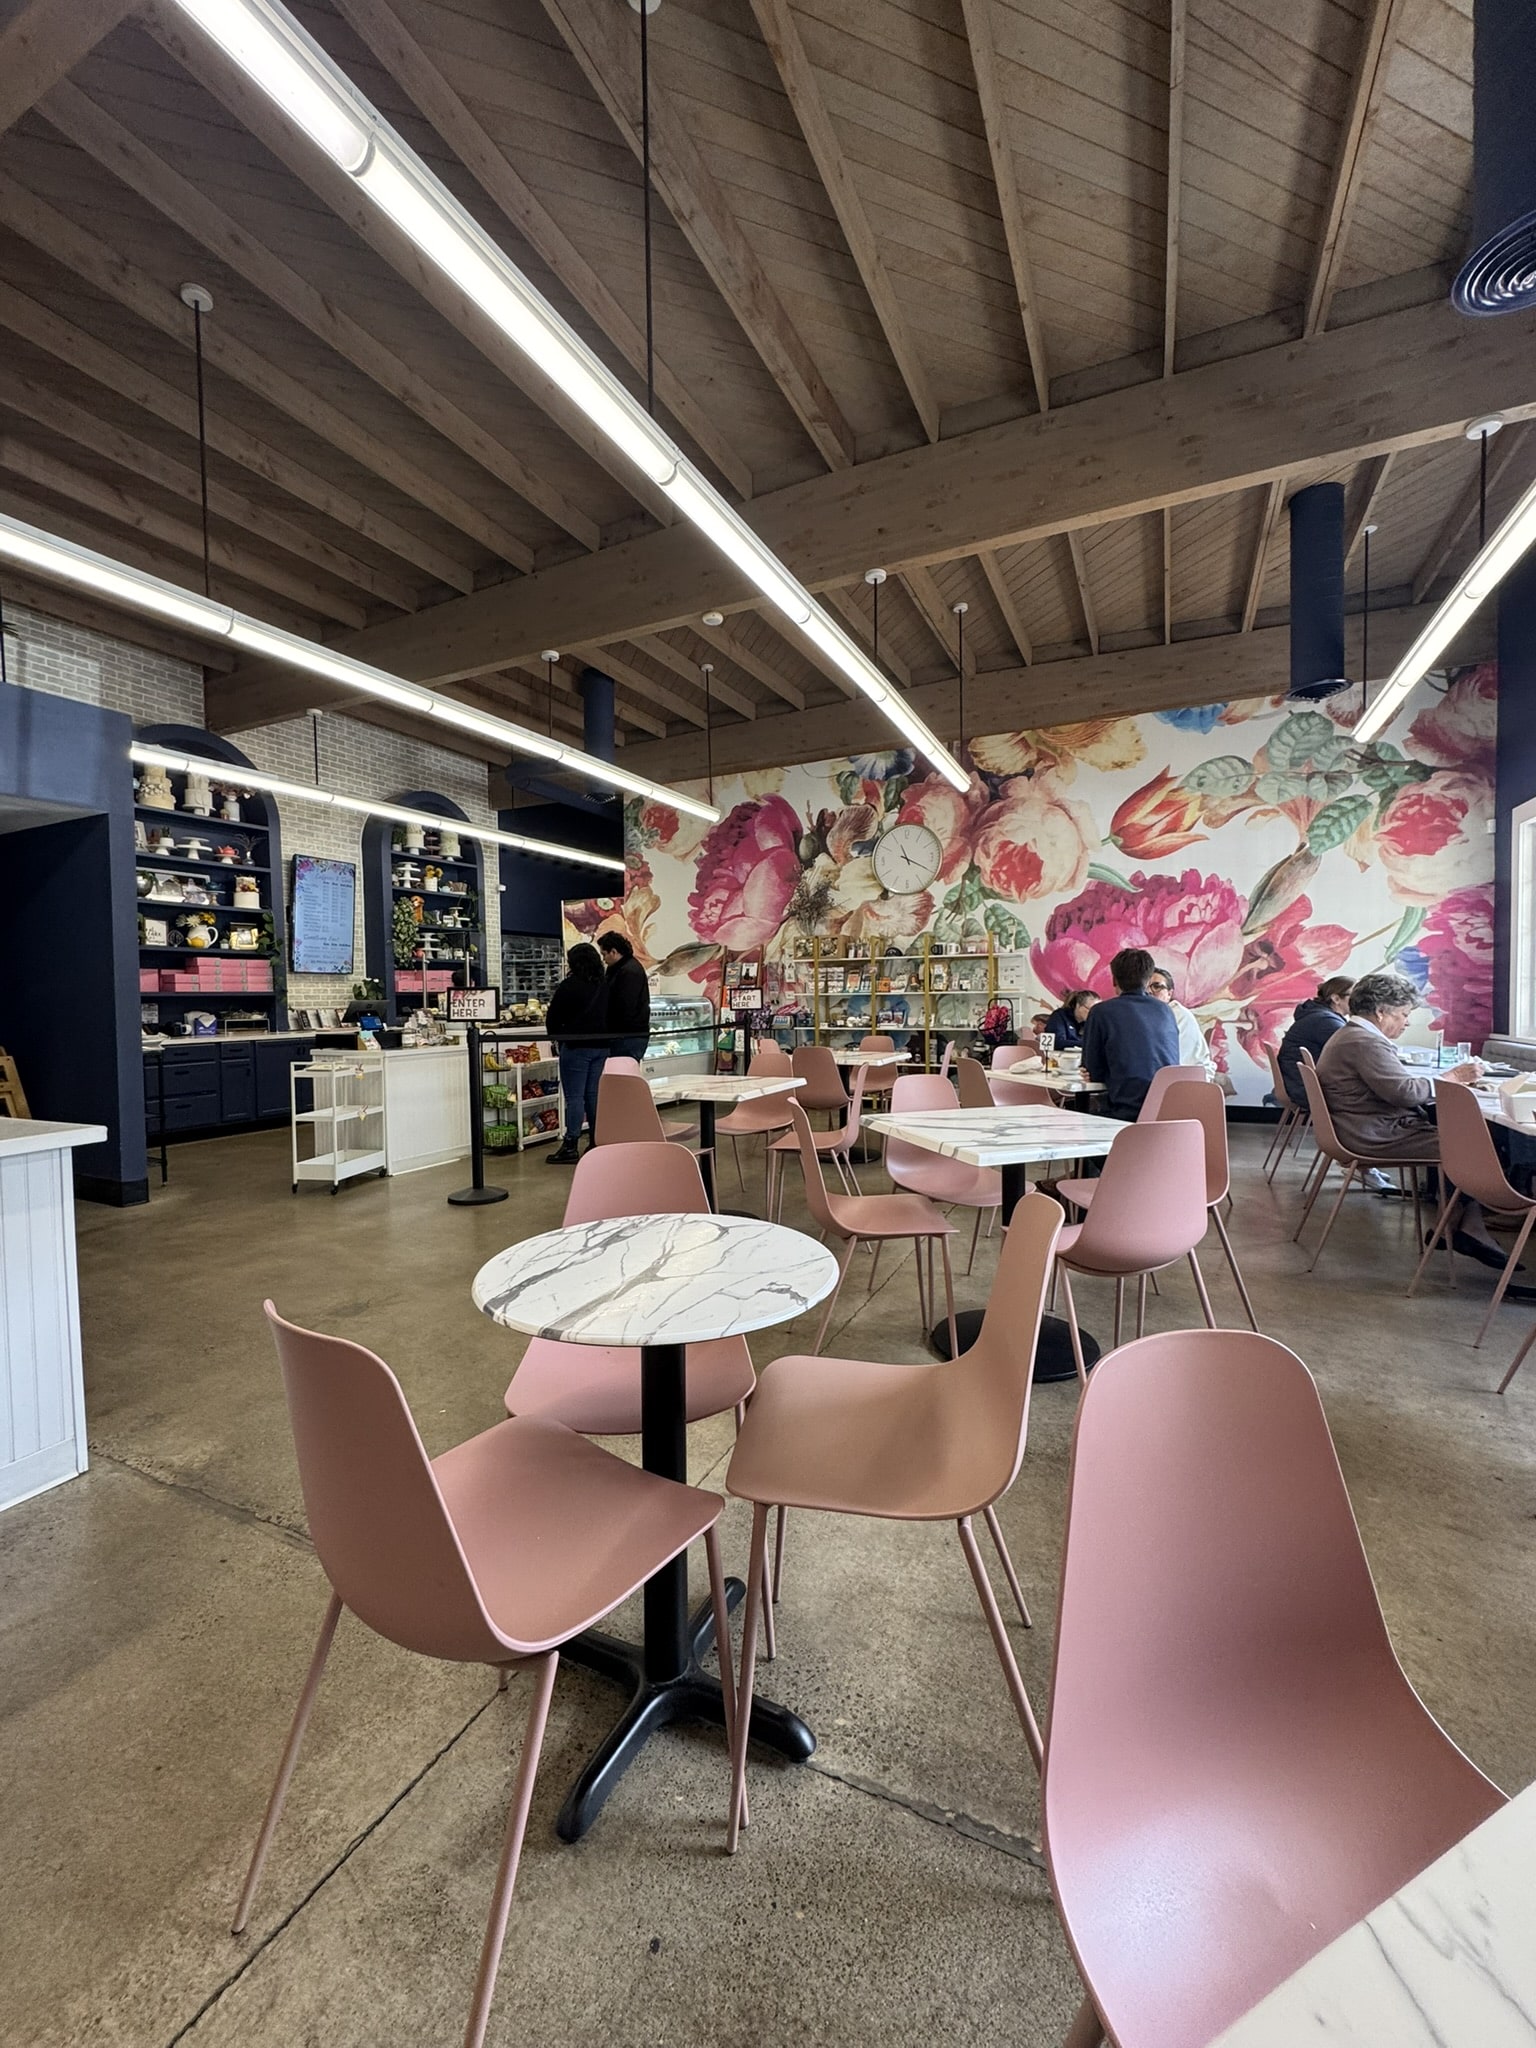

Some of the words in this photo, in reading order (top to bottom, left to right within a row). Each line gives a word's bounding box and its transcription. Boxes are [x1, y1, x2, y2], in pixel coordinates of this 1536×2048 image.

[452, 998, 486, 1008] ENTER
[452, 1008, 479, 1017] HERE
[1041, 1035, 1053, 1047] 22
